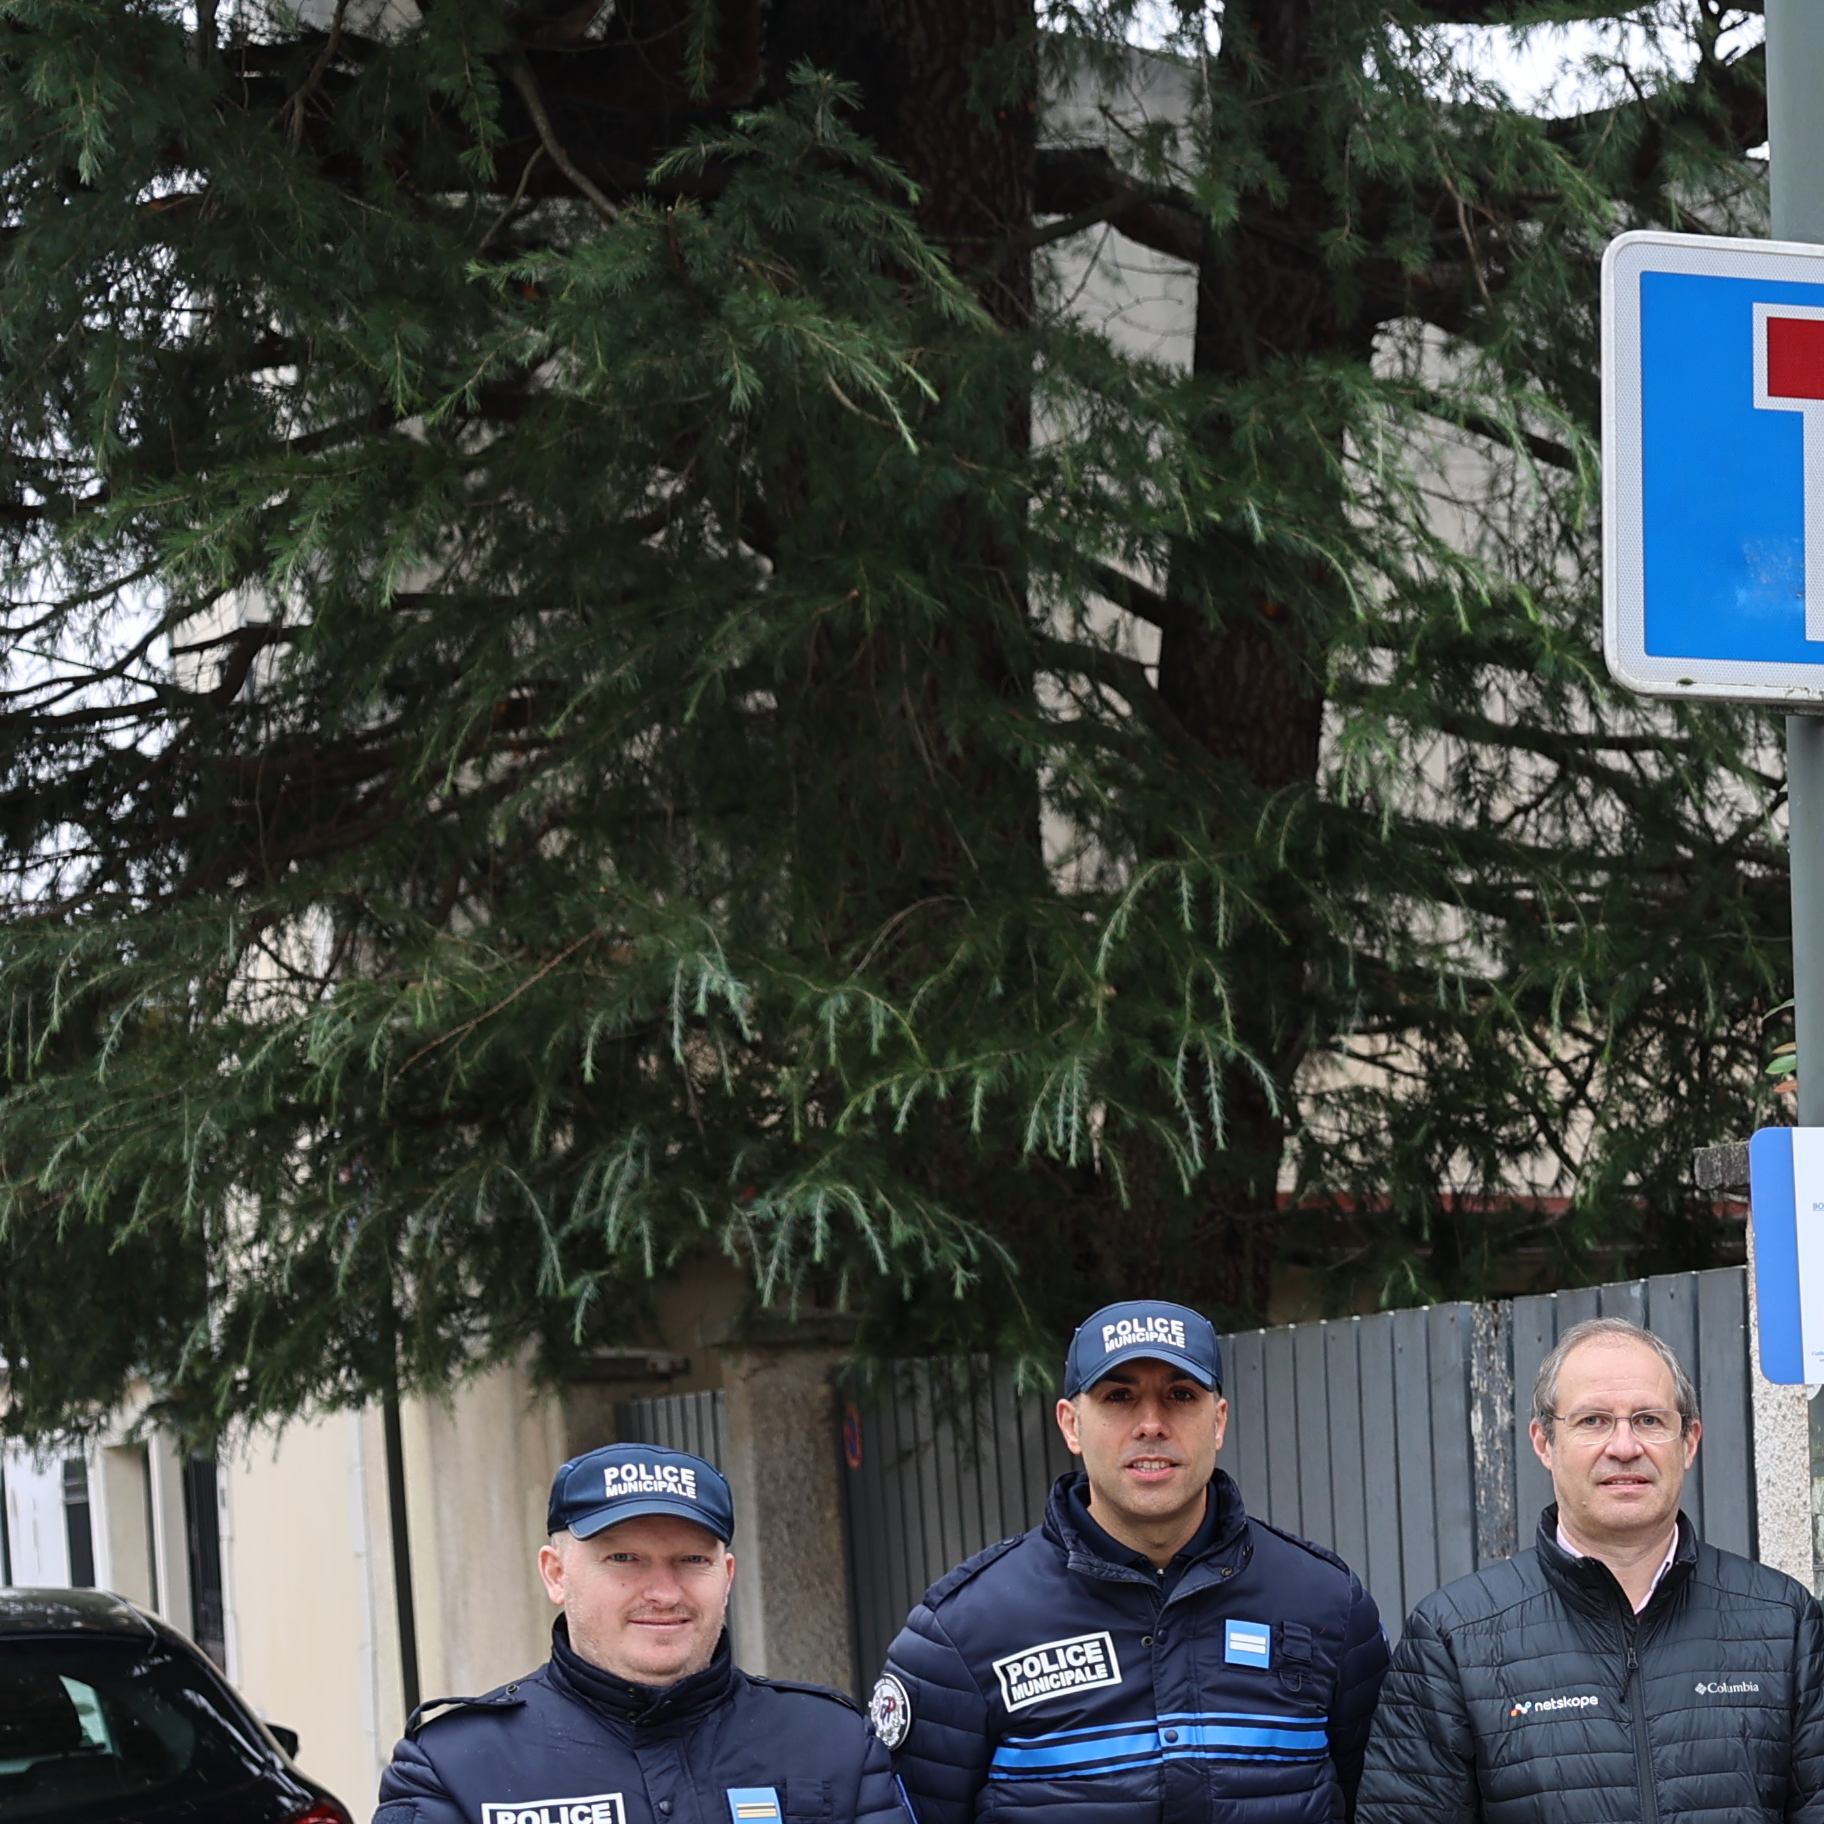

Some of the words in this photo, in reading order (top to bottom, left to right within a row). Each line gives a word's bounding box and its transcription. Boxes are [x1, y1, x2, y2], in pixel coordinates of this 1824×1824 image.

[1102, 1316, 1185, 1342] POLICE
[1104, 1331, 1186, 1354] MUNICIPALE
[603, 1463, 696, 1487] POLICE
[605, 1480, 697, 1499] MUNICIPALE
[1005, 1640, 1105, 1685] POLICE
[1010, 1663, 1109, 1701] MUNICIPALE
[1707, 1682, 1759, 1694] Columbia
[1535, 1695, 1598, 1713] netskope
